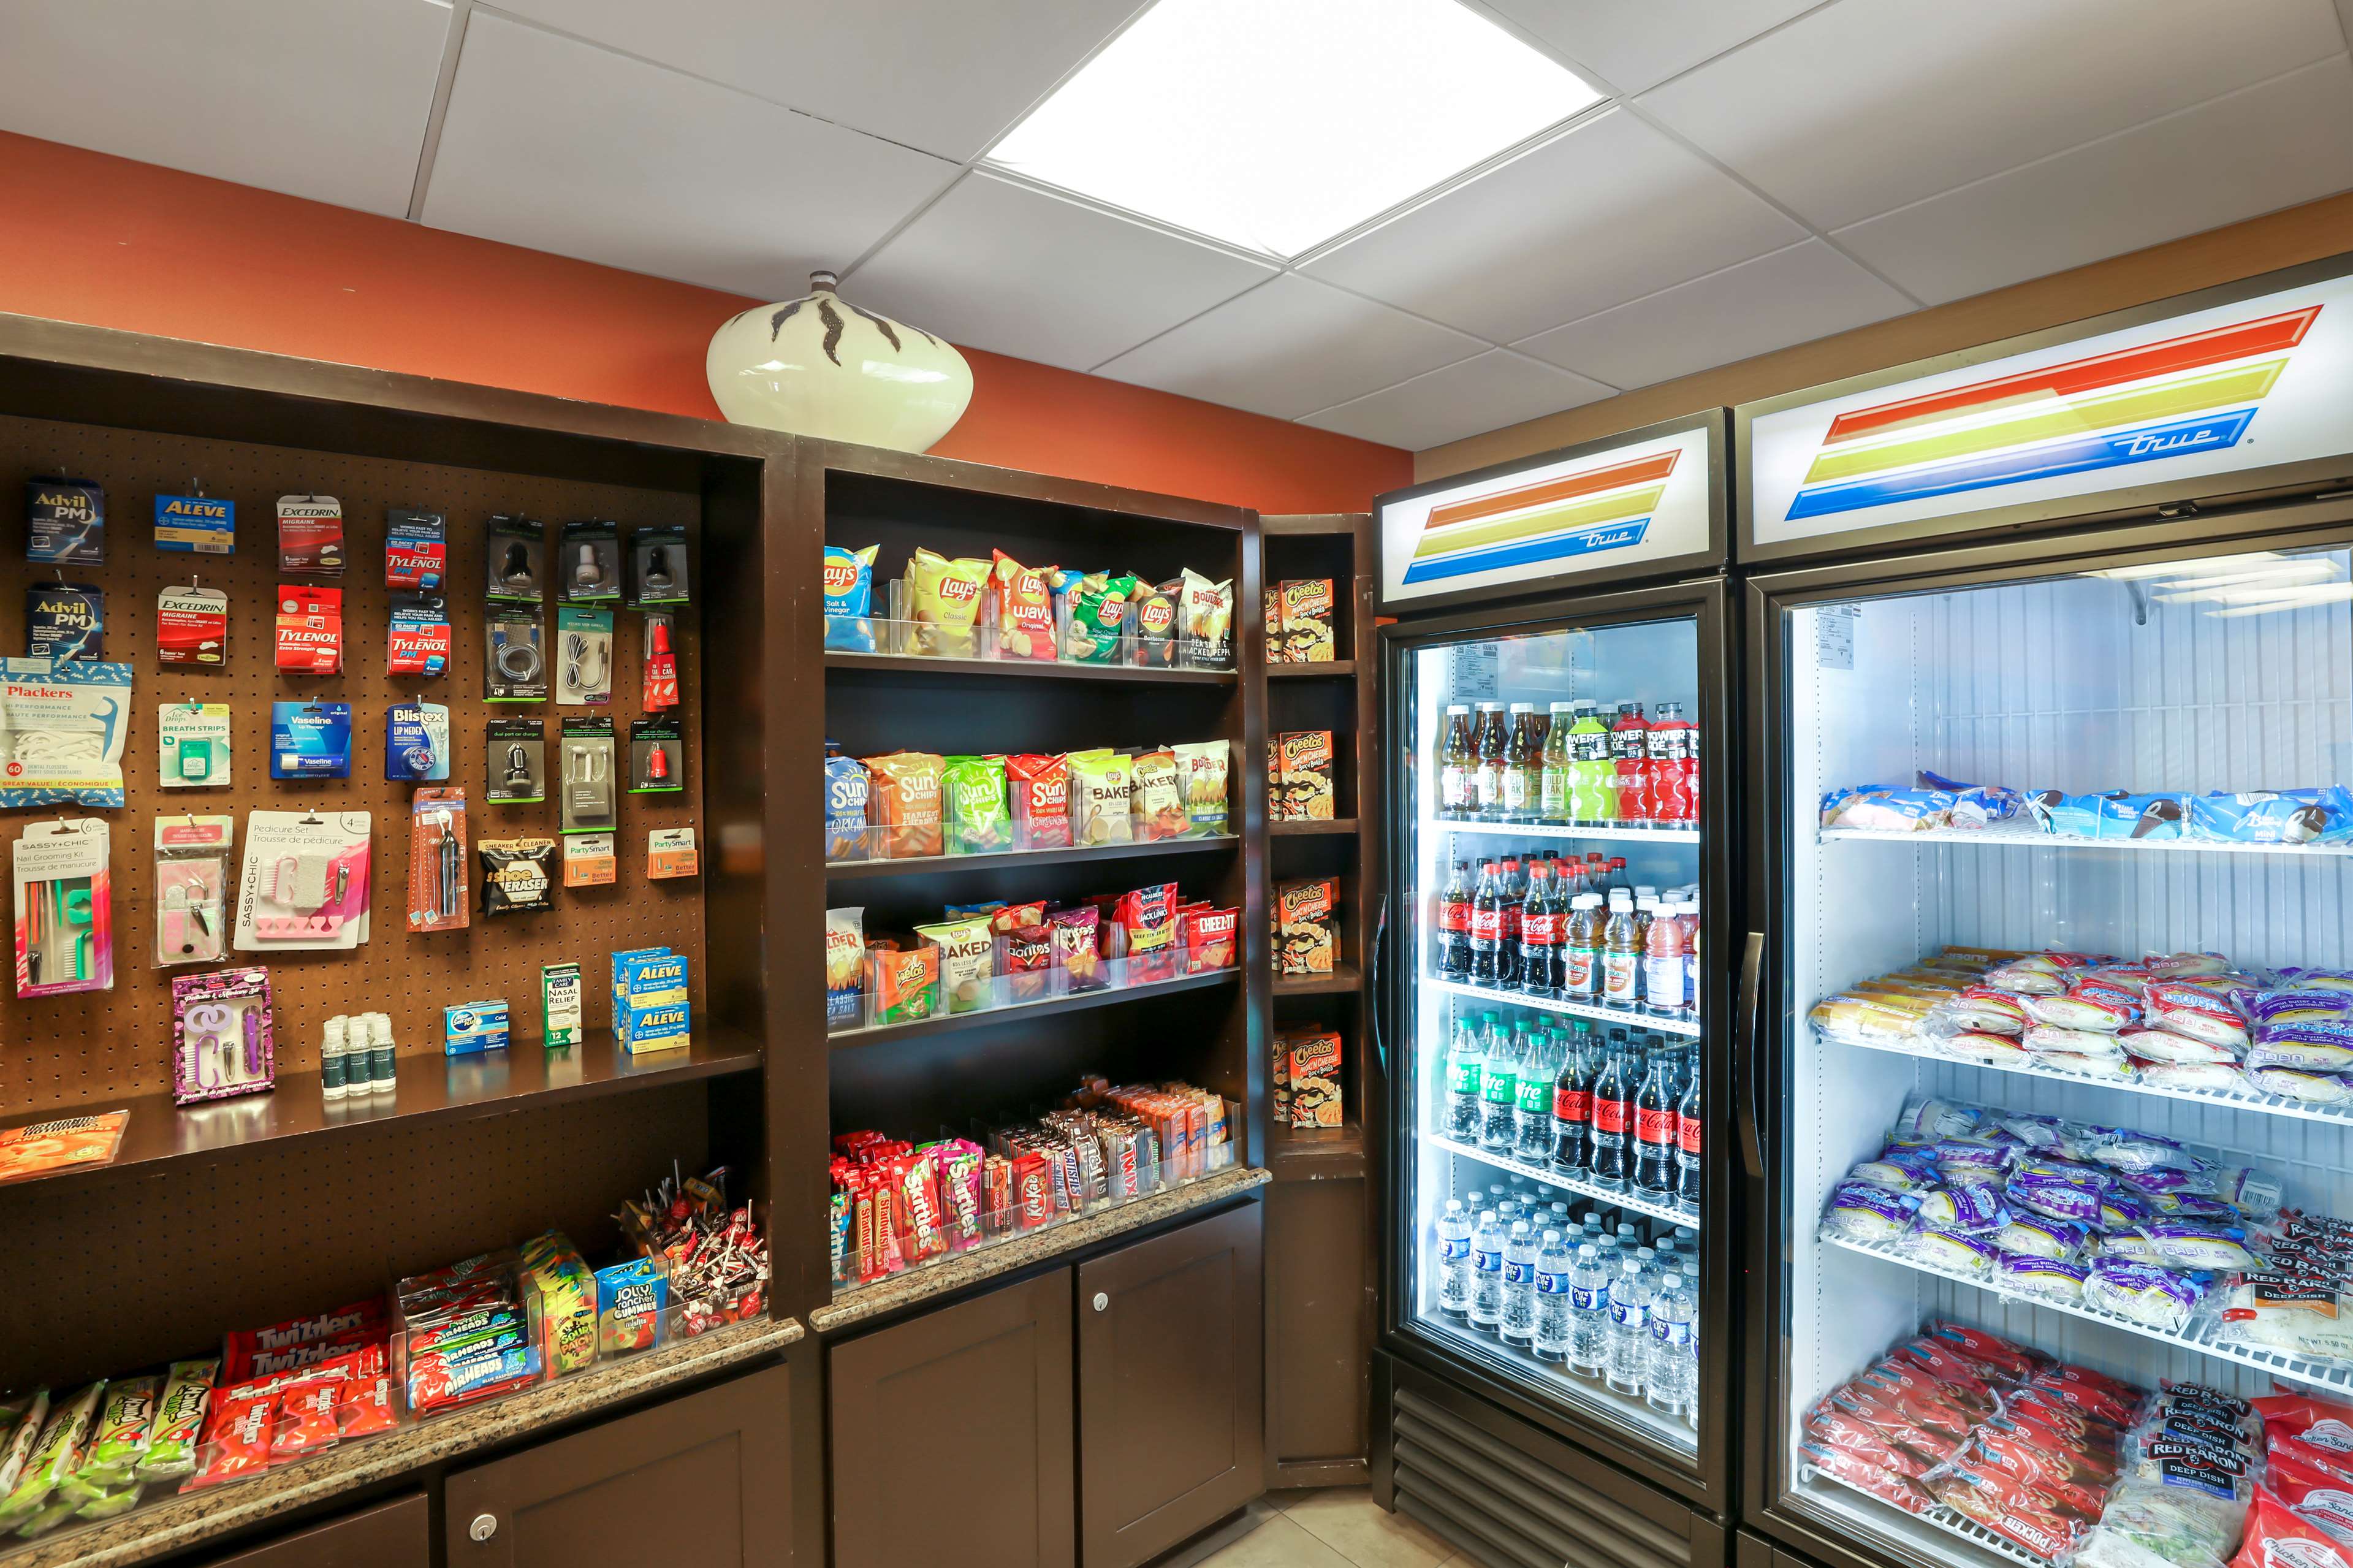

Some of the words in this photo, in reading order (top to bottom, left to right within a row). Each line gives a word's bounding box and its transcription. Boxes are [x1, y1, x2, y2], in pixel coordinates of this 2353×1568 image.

[35, 493, 85, 508] Advil
[55, 507, 86, 520] PM
[165, 501, 225, 517] ALEVE
[281, 508, 338, 517] EXCEDRIN
[389, 555, 441, 569] TYLENOL
[941, 577, 976, 601] Lay's
[1287, 581, 1325, 606] Cheetos
[162, 601, 224, 612] EXCEDRIN
[1192, 591, 1224, 609] BOULDER
[36, 601, 85, 614] Advil
[55, 614, 86, 626] PM
[944, 612, 967, 621] Classic
[1013, 605, 1051, 625] wavy
[1144, 605, 1171, 624] Lay's
[279, 630, 337, 642] TYLENOL
[393, 639, 446, 650] TYLENOL
[7, 687, 73, 698] Plackers
[394, 710, 443, 723] Blistex
[404, 727, 423, 736] MEDEX
[1285, 734, 1324, 759] Cheetos
[1309, 748, 1328, 760] CHEESE
[831, 781, 868, 809] Sun
[900, 775, 938, 803] Sun
[1032, 780, 1066, 806] Sun
[1093, 786, 1128, 801] BAKE
[970, 794, 997, 805] CHIPS
[1046, 796, 1066, 804] CHIPS
[903, 811, 939, 820] HARVEST
[254, 824, 293, 834] Pedicure
[304, 834, 343, 845] pédicure
[34, 853, 72, 863] Grooming
[60, 861, 97, 869] manucure
[504, 878, 548, 892] ERASER
[1285, 886, 1323, 911] Cheetos
[1308, 899, 1328, 911] CHEESE
[1140, 912, 1153, 923] JACK
[637, 965, 681, 981] ALEVE
[549, 996, 576, 1005] RELIEF
[640, 1011, 685, 1027] ALEVE
[1295, 1041, 1333, 1065] Cheetos
[1318, 1054, 1338, 1067] CHEESE
[3, 1135, 42, 1146] HAND
[45, 1127, 112, 1138] WARMERS
[1065, 1151, 1081, 1197] SATISFIES
[1119, 1147, 1138, 1197] TWIX
[1054, 1162, 1068, 1209] SNICKERS
[949, 1163, 976, 1238] Skittles
[904, 1175, 932, 1249] Skittles
[2291, 1224, 2321, 1236] RED
[1505, 1262, 1518, 1272] Pure
[1506, 1267, 1518, 1277] Life
[1535, 1272, 1550, 1283] Pure
[1537, 1277, 1549, 1288] Life
[2247, 1273, 2281, 1282] RED
[615, 1284, 650, 1303] JOLLY
[1573, 1287, 1588, 1298] Pure
[1575, 1294, 1587, 1303] Life
[618, 1292, 655, 1309] rancher
[1611, 1300, 1624, 1311] Pure
[614, 1302, 656, 1320] GUMMIES
[1611, 1305, 1624, 1317] Life
[1652, 1316, 1667, 1327] Pure
[256, 1312, 363, 1349] Twizzlers
[1654, 1323, 1666, 1334] Life
[438, 1338, 494, 1366] AIRHEADS
[444, 1358, 503, 1397] AIRHEADS
[495, 1369, 522, 1381] RASPBERRY
[2171, 1386, 2198, 1395] RED
[177, 1386, 209, 1419] PUNCH
[2202, 1434, 2226, 1445] DISH
[2154, 1444, 2182, 1454] RED
[2186, 1447, 2237, 1470] BARON
[2170, 1465, 2196, 1475] DEEP
[2200, 1471, 2224, 1484] DISH
[2176, 1477, 2203, 1487] PEPPERONI
